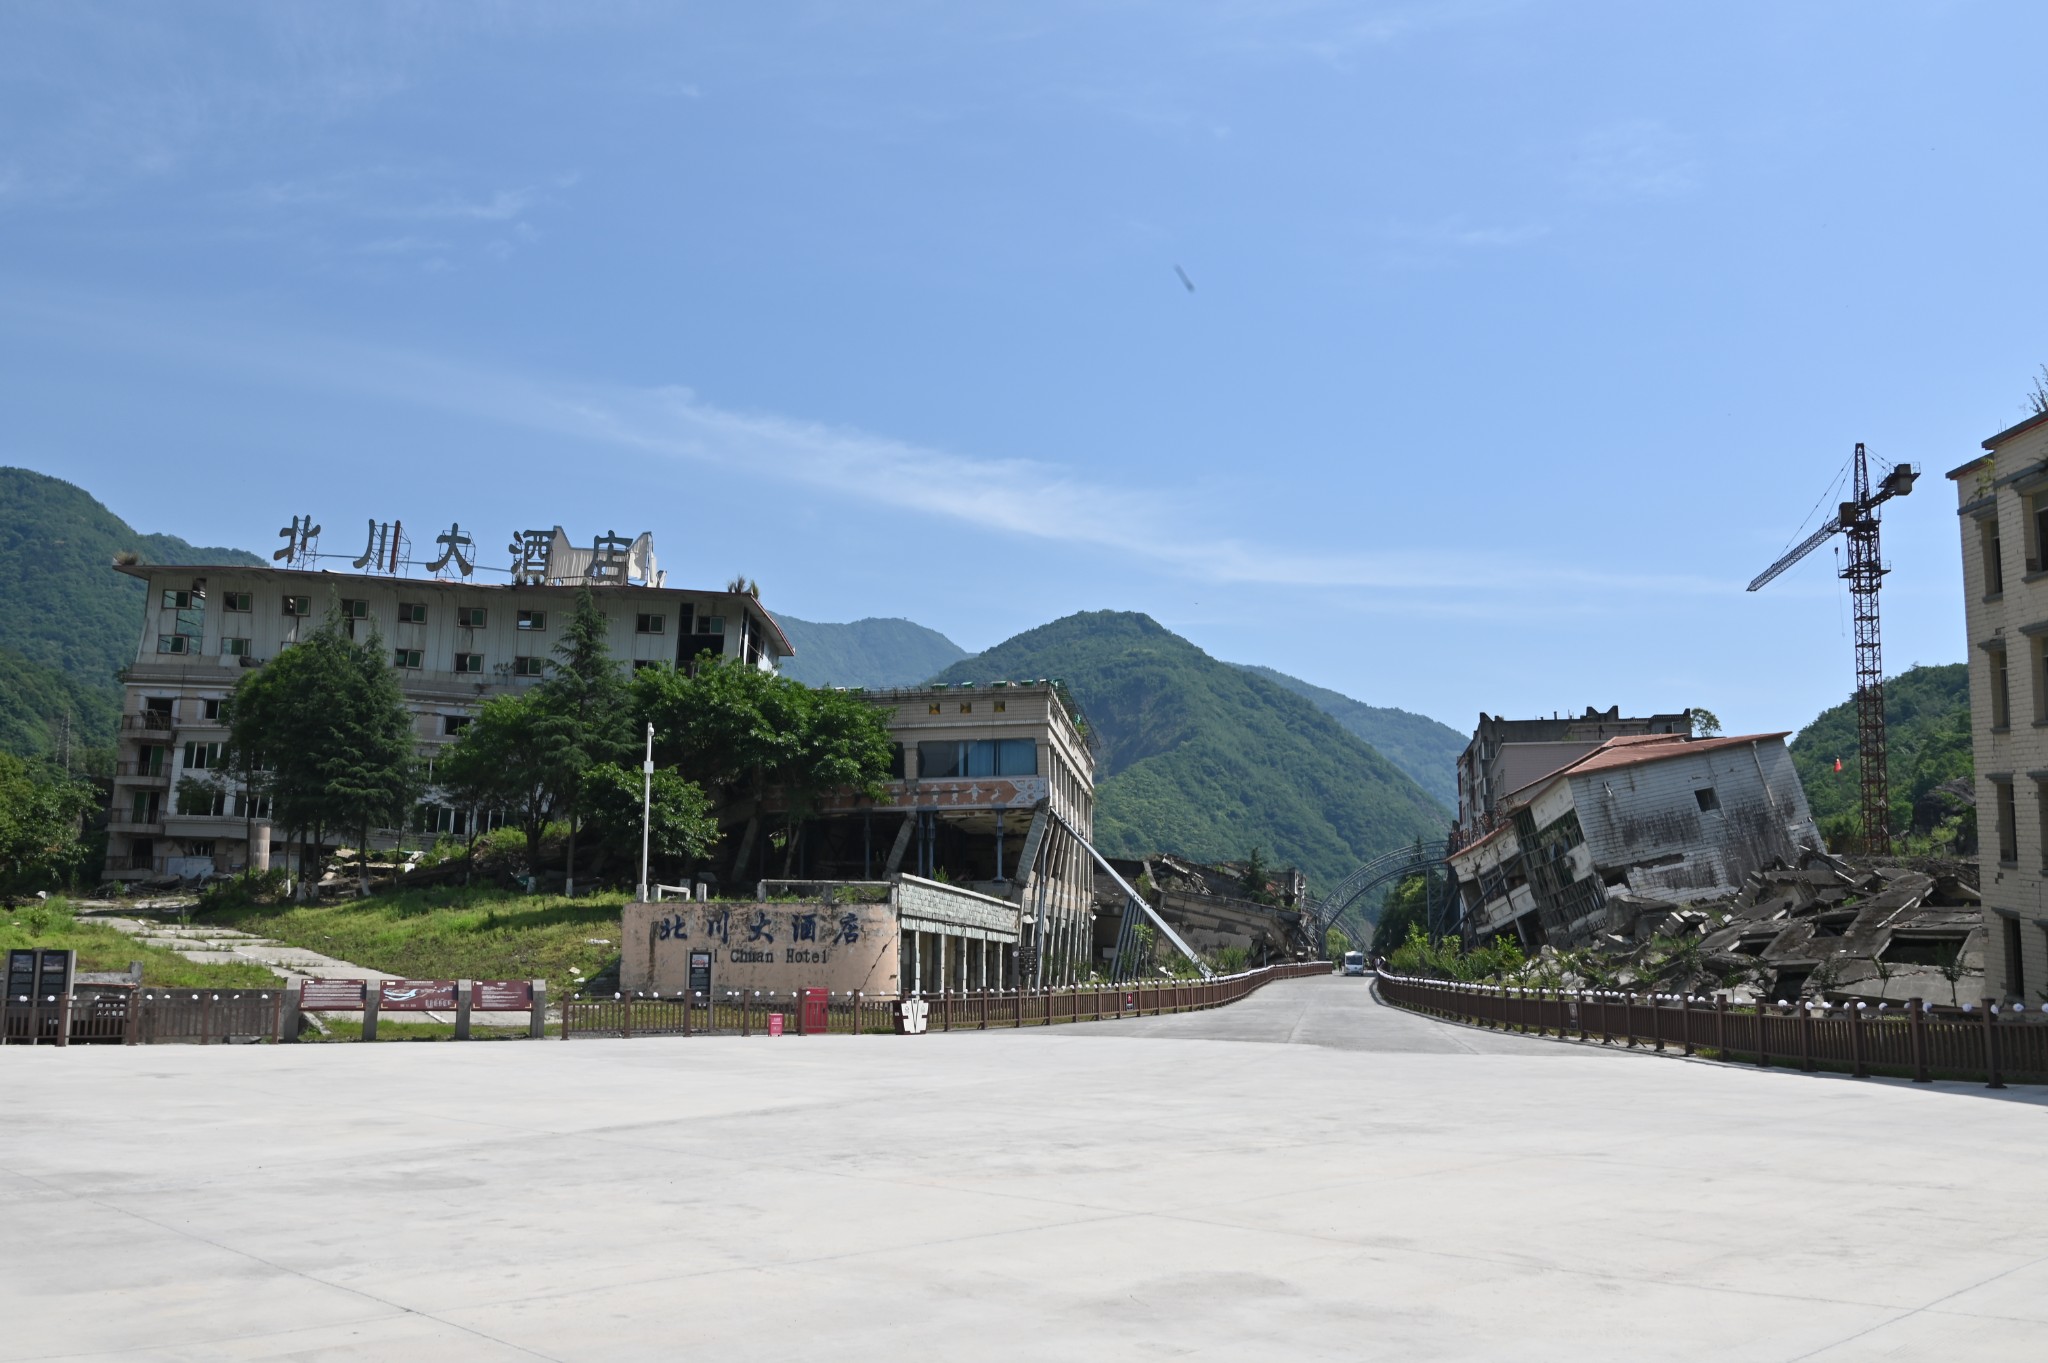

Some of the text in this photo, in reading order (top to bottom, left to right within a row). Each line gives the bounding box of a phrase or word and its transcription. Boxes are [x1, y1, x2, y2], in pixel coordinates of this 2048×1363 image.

[273, 514, 634, 585] 北川大酒店
[659, 911, 860, 945] 北川大酒店
[730, 949, 775, 963] Chuan
[785, 949, 829, 963] Hotel
